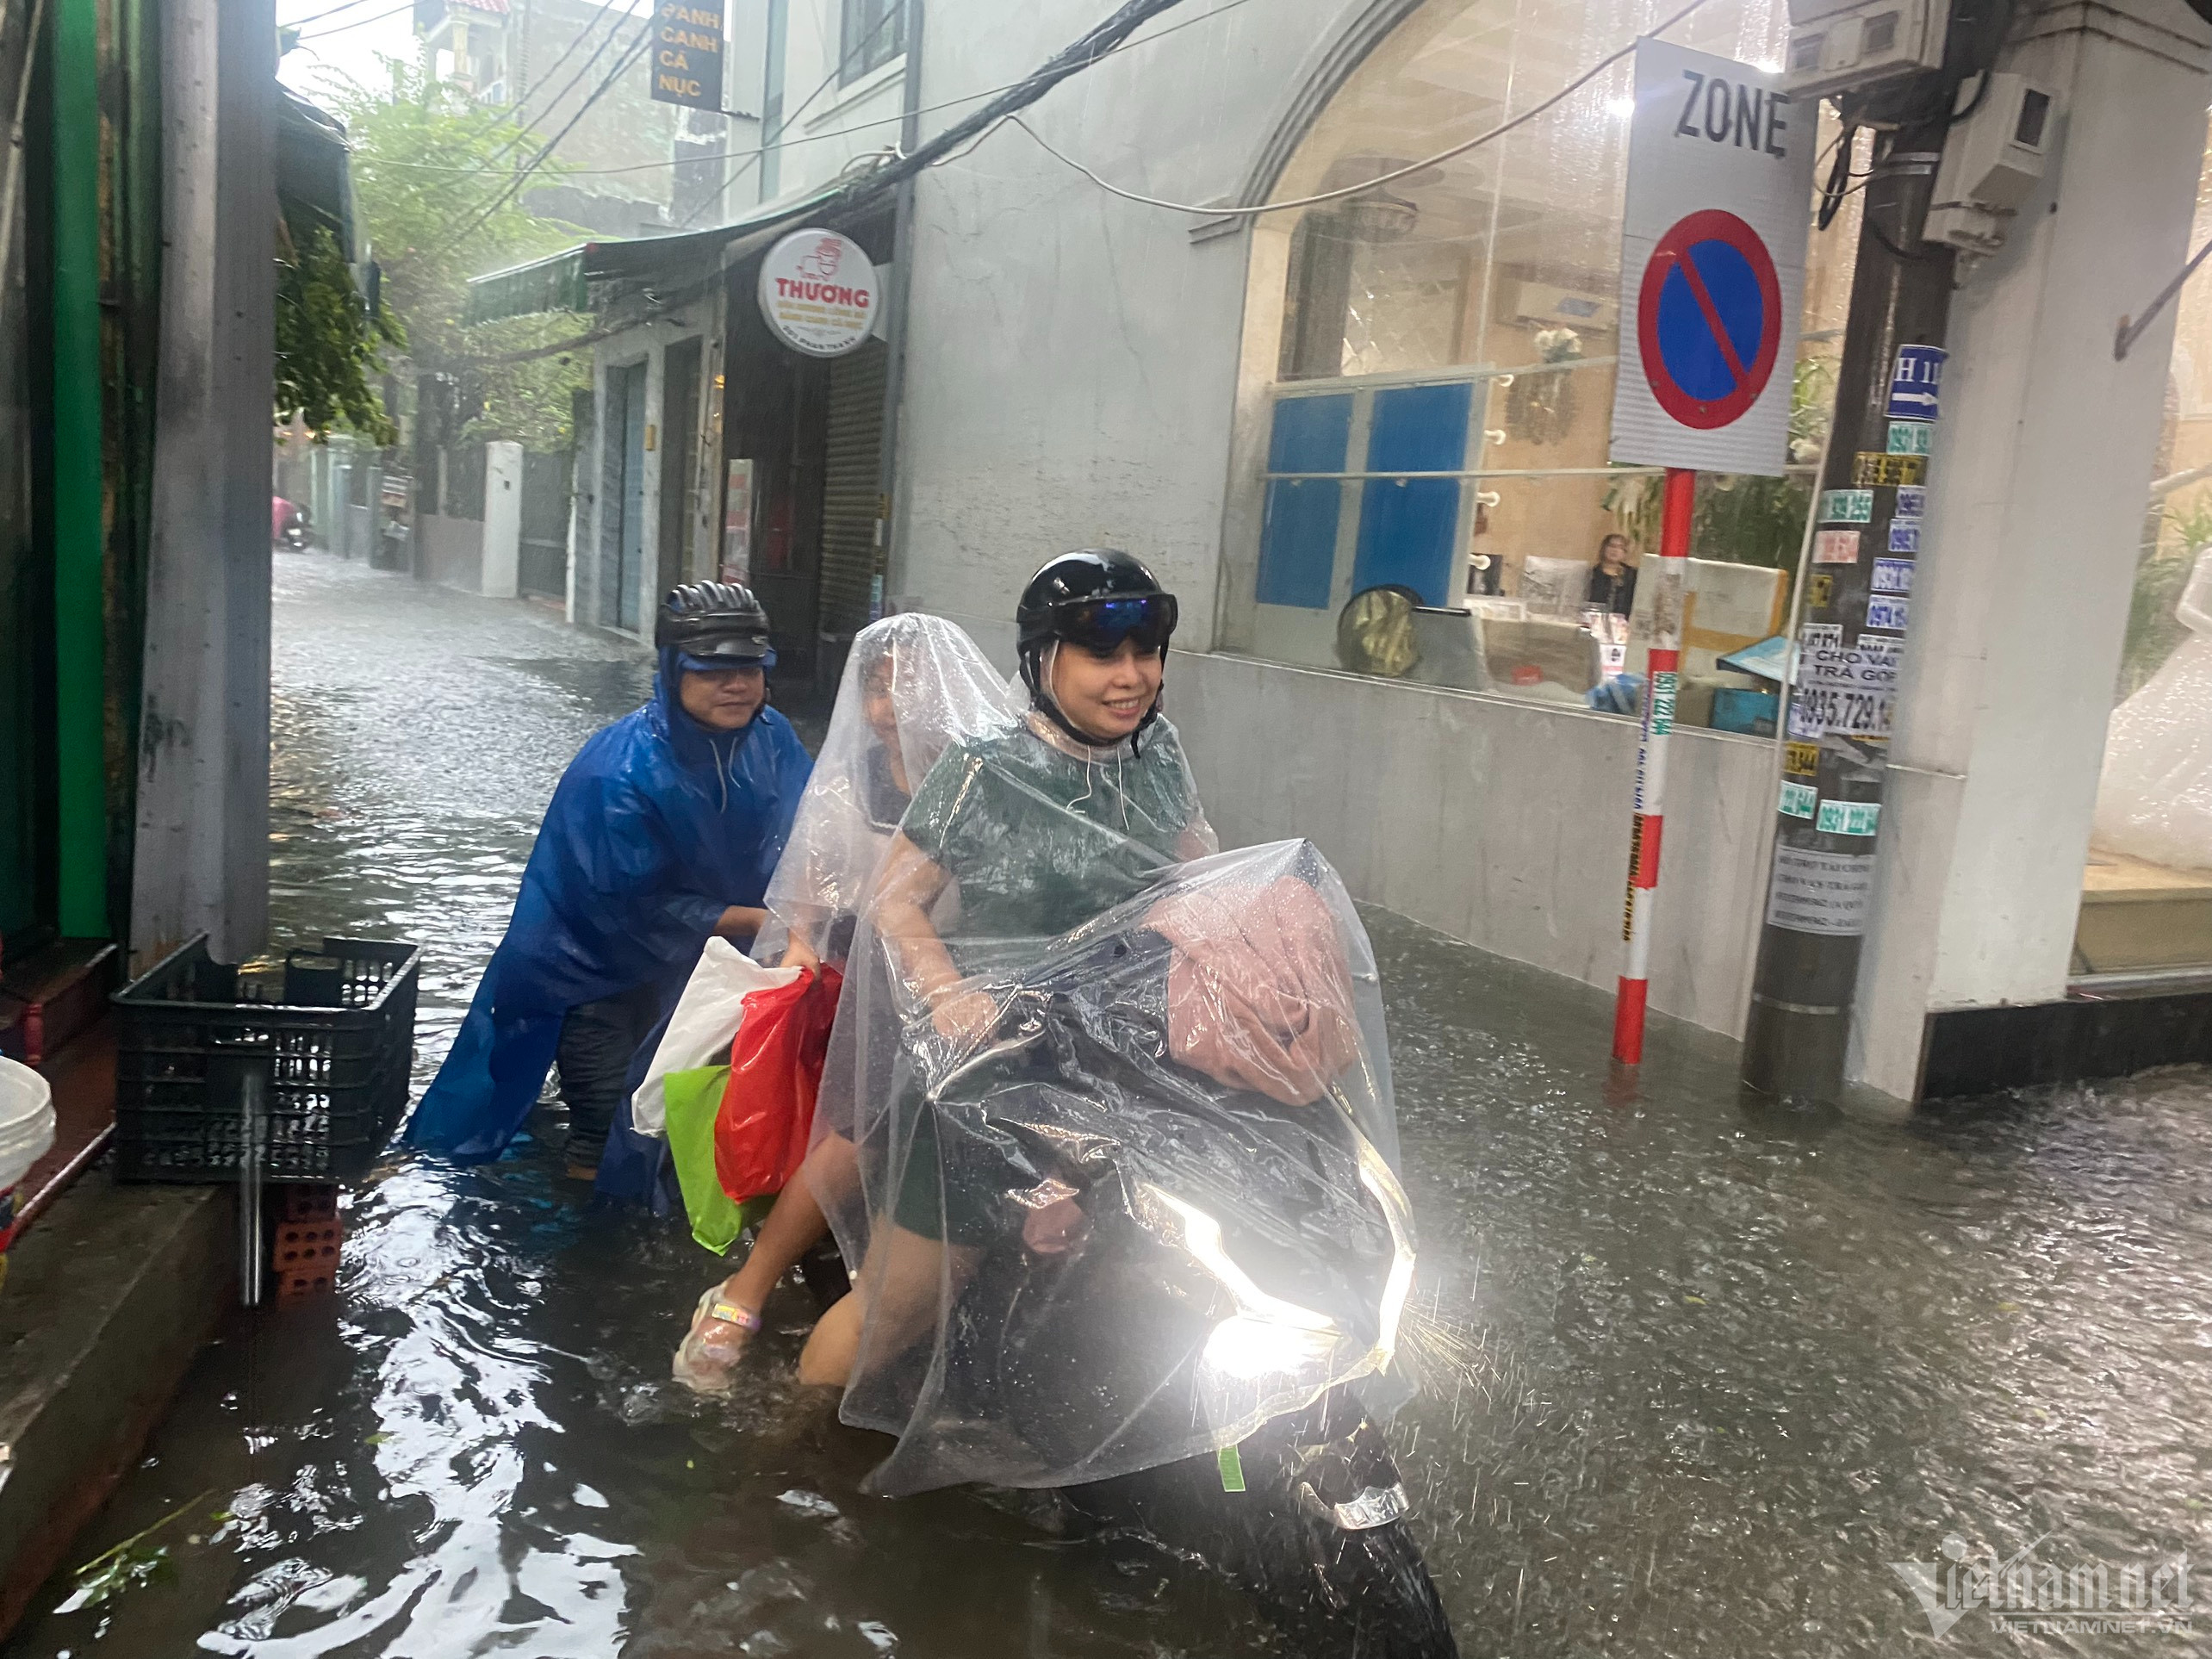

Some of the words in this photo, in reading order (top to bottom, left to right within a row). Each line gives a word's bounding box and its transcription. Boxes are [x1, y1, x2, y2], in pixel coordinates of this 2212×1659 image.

[1678, 68, 1793, 158] ZONE
[1894, 357, 1917, 382] H
[1816, 649, 1862, 664] CHO
